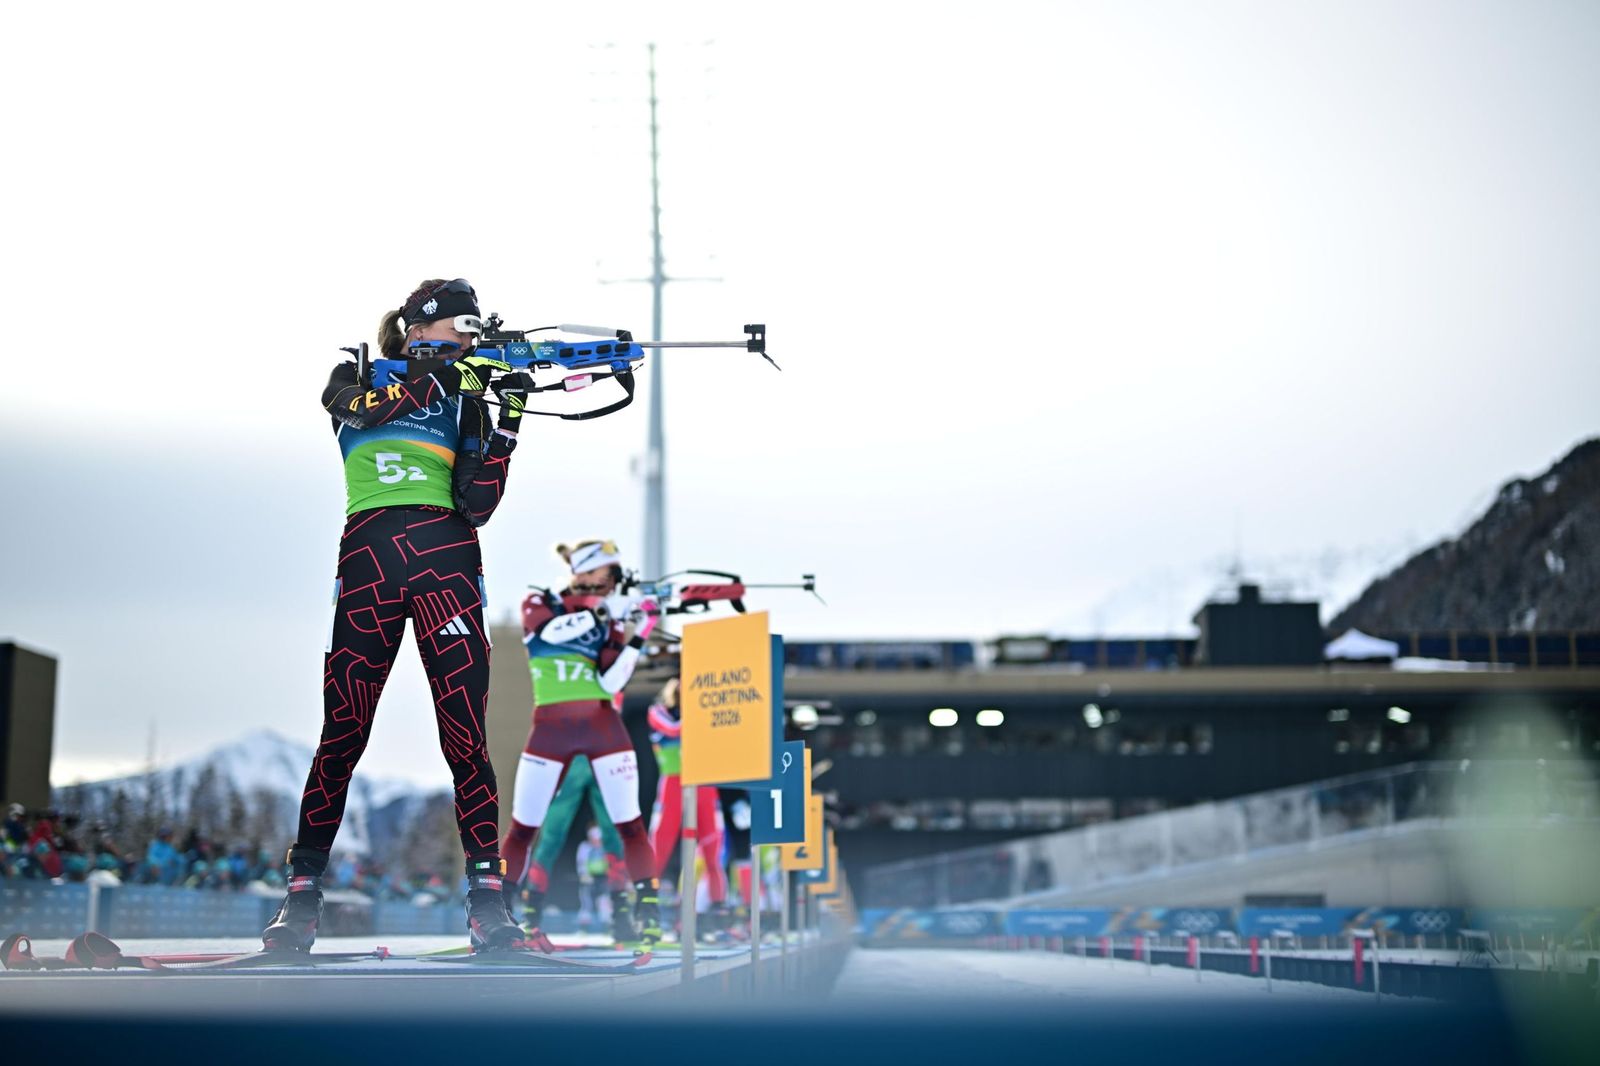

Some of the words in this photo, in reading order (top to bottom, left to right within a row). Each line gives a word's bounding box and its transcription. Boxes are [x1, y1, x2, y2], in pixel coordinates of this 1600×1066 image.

[393, 420, 428, 431] CORTINA
[430, 427, 445, 437] 2026
[689, 666, 751, 690] MILANO
[699, 688, 763, 708] CORTINA
[711, 709, 741, 728] 2026
[770, 789, 783, 828] 1
